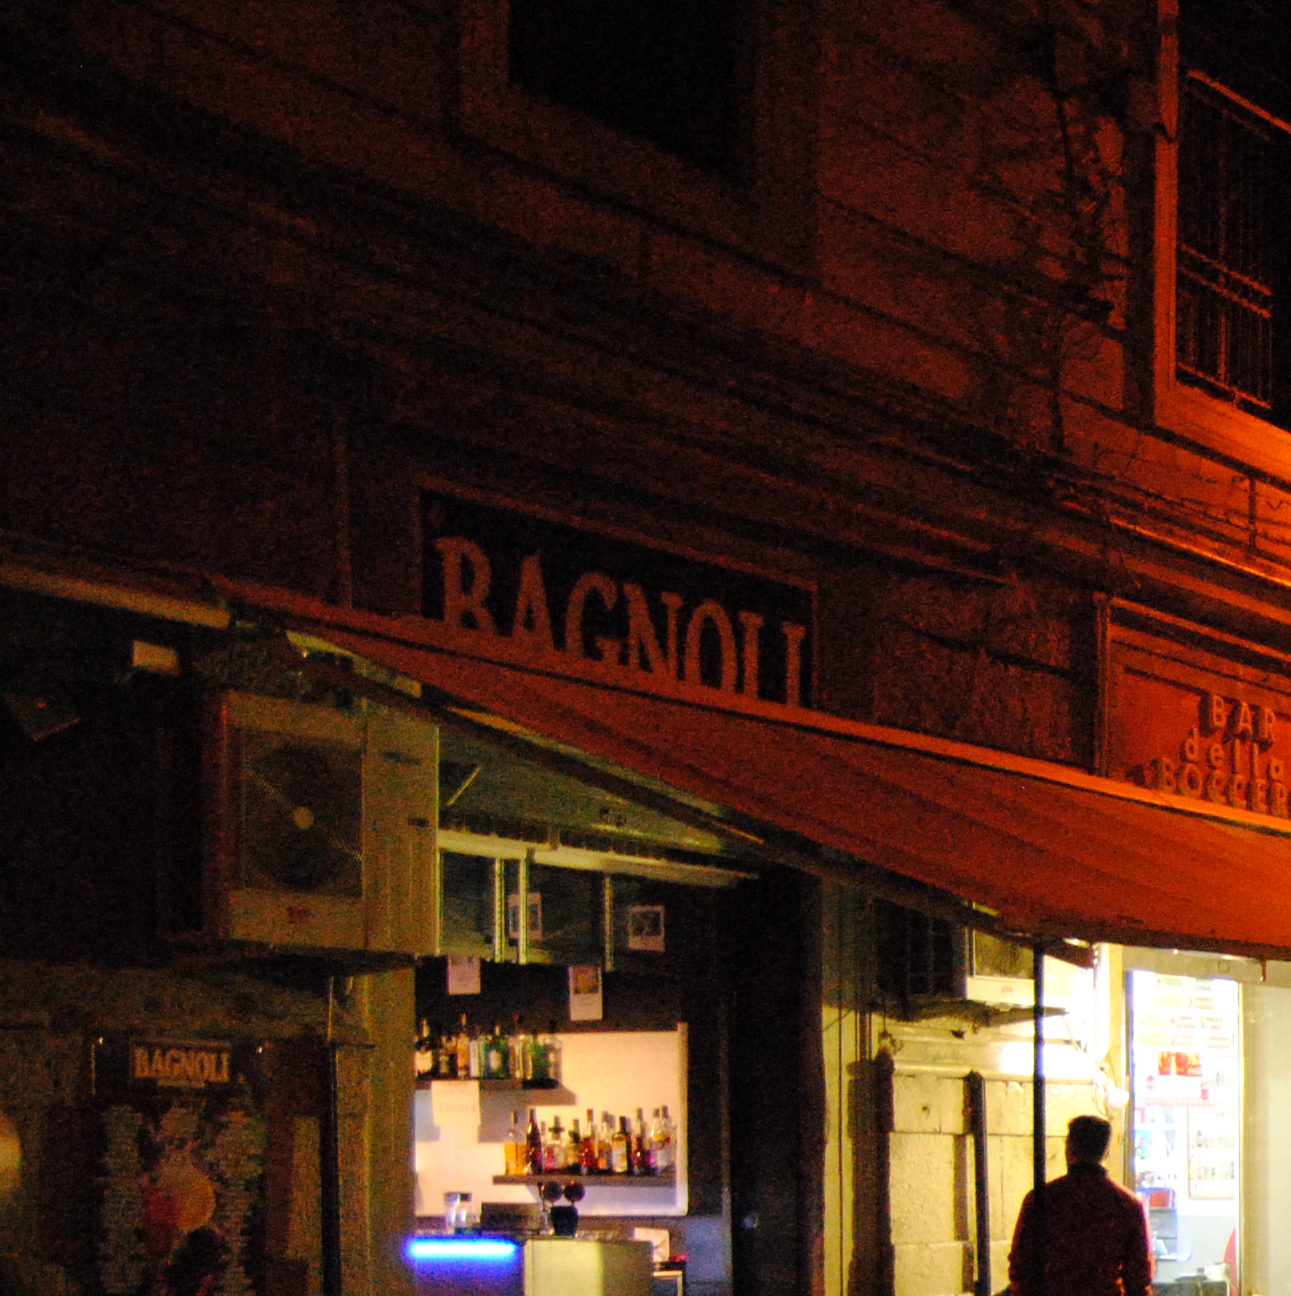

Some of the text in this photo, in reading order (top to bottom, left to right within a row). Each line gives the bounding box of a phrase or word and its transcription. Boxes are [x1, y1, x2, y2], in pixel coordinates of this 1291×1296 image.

[435, 535, 807, 706] BAGNOLI
[1211, 694, 1277, 742] BAR
[1184, 726, 1286, 782] della
[133, 1046, 231, 1083] BAGNOLI
